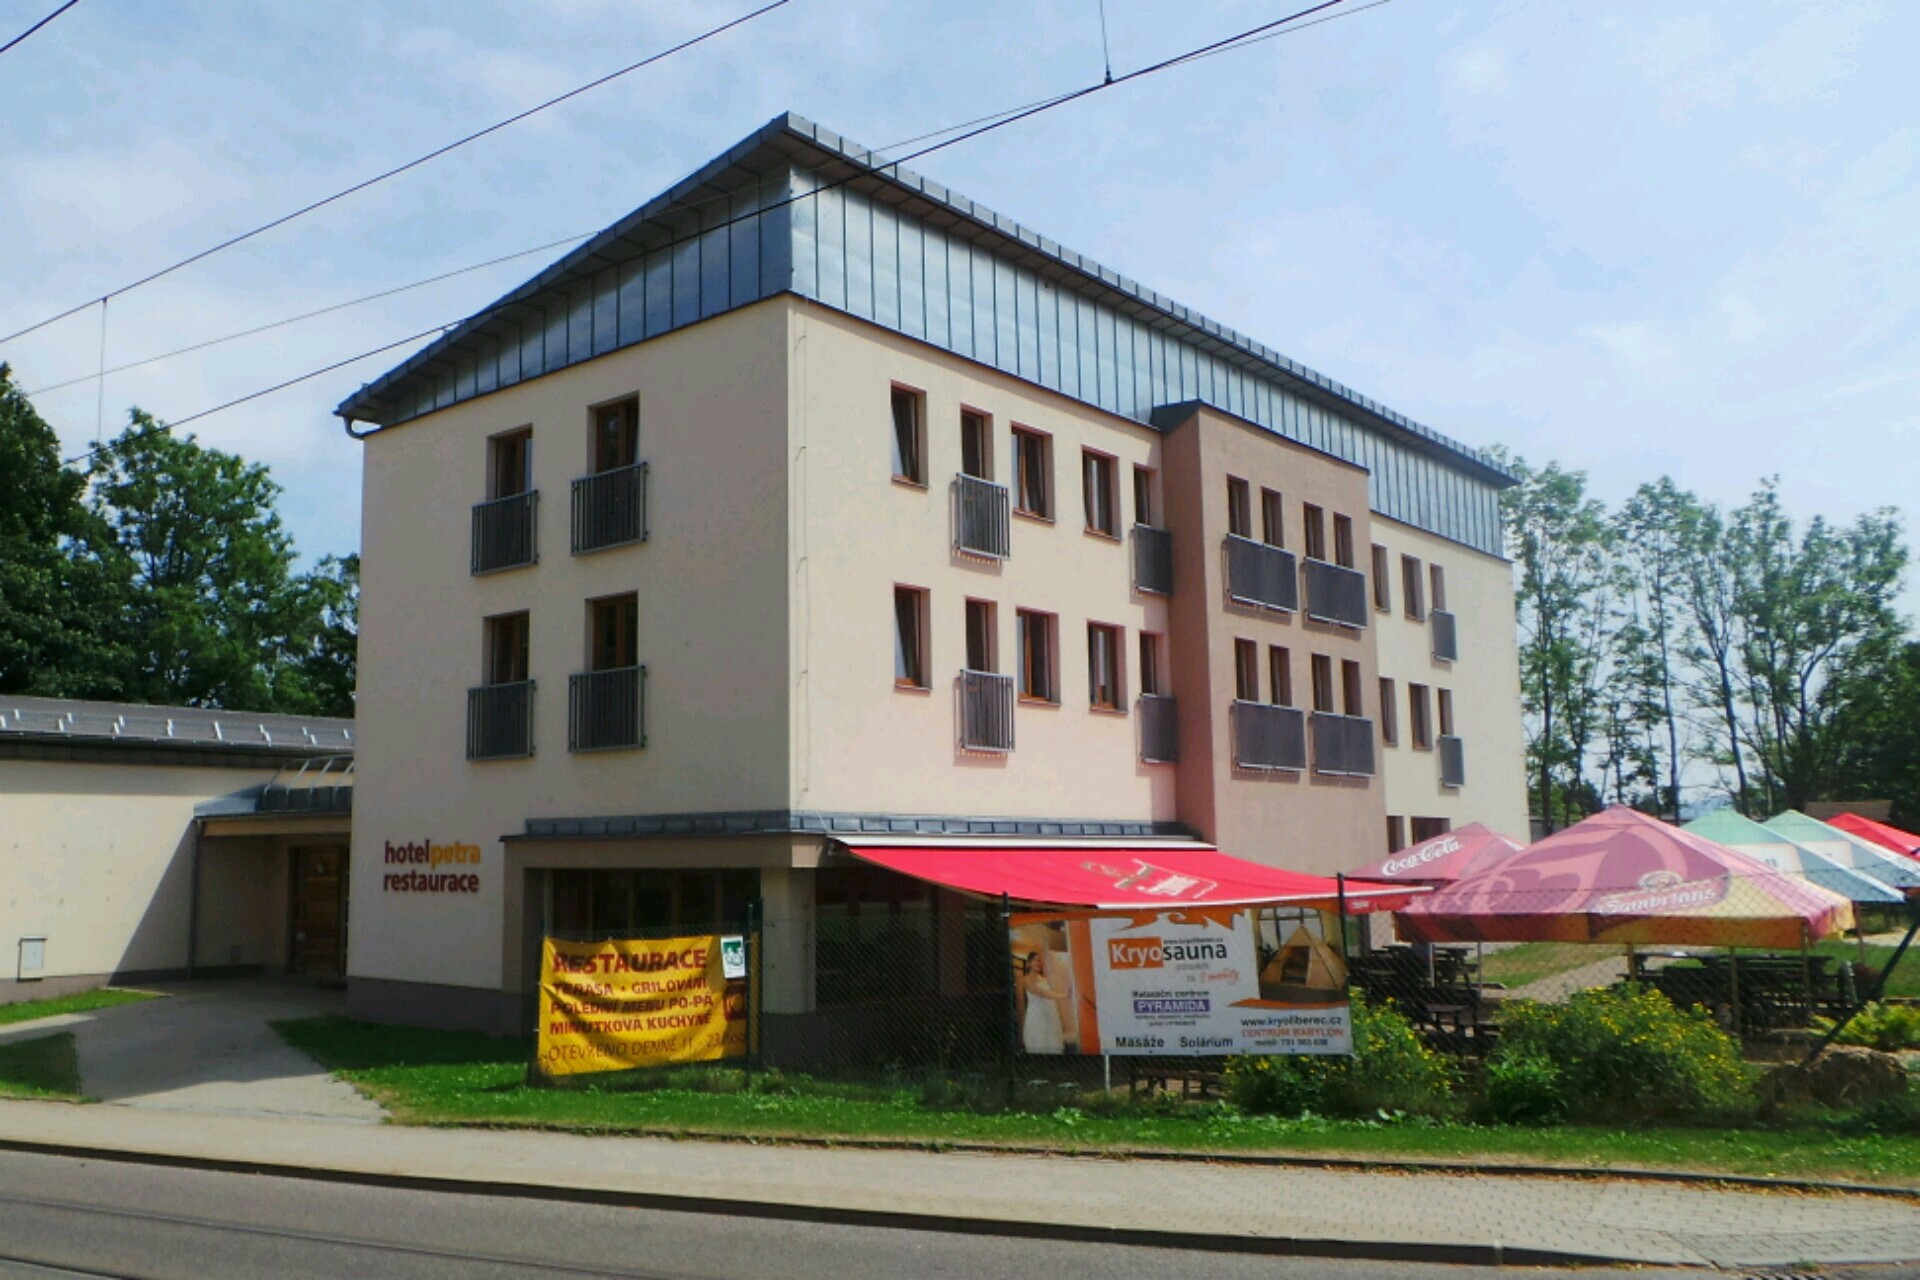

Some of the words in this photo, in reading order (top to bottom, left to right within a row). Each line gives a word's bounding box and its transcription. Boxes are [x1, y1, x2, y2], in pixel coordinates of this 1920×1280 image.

[1382, 836, 1463, 876] Coca-Cola
[383, 869, 480, 893] restaurace
[553, 949, 707, 974] RESTAURACE
[552, 982, 613, 996] TERASA
[622, 999, 664, 1013] MENU
[1137, 1000, 1207, 1012] PYRAMIDA
[1115, 1034, 1165, 1048] Masáže
[1180, 1034, 1234, 1048] Solárium
